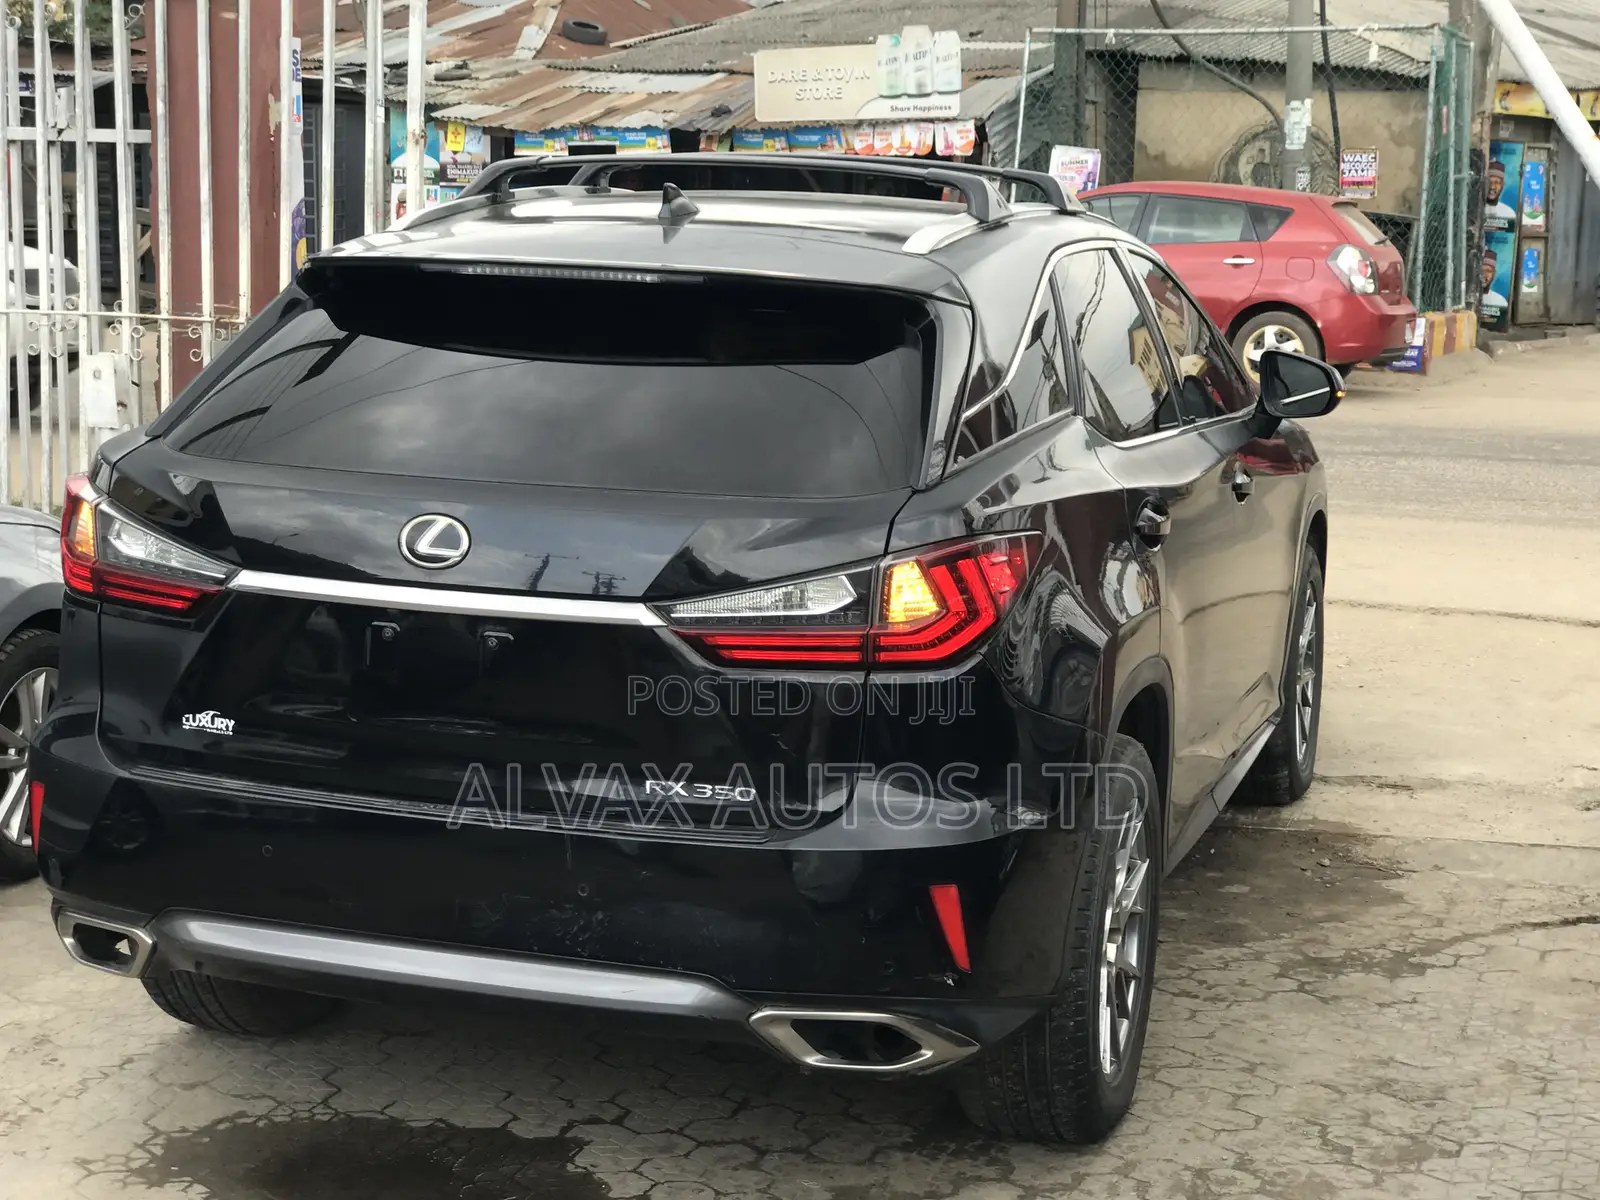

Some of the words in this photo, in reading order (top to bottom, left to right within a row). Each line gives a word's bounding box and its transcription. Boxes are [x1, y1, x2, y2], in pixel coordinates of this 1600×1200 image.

[768, 69, 808, 83] DARE
[812, 68, 823, 82] &
[795, 86, 843, 101] STORE
[890, 104, 911, 113] Share
[912, 103, 952, 113] Happiness
[1343, 153, 1376, 162] WAEC
[1343, 169, 1376, 177] JAMB
[645, 780, 689, 797] RX
[692, 783, 757, 802] 350
